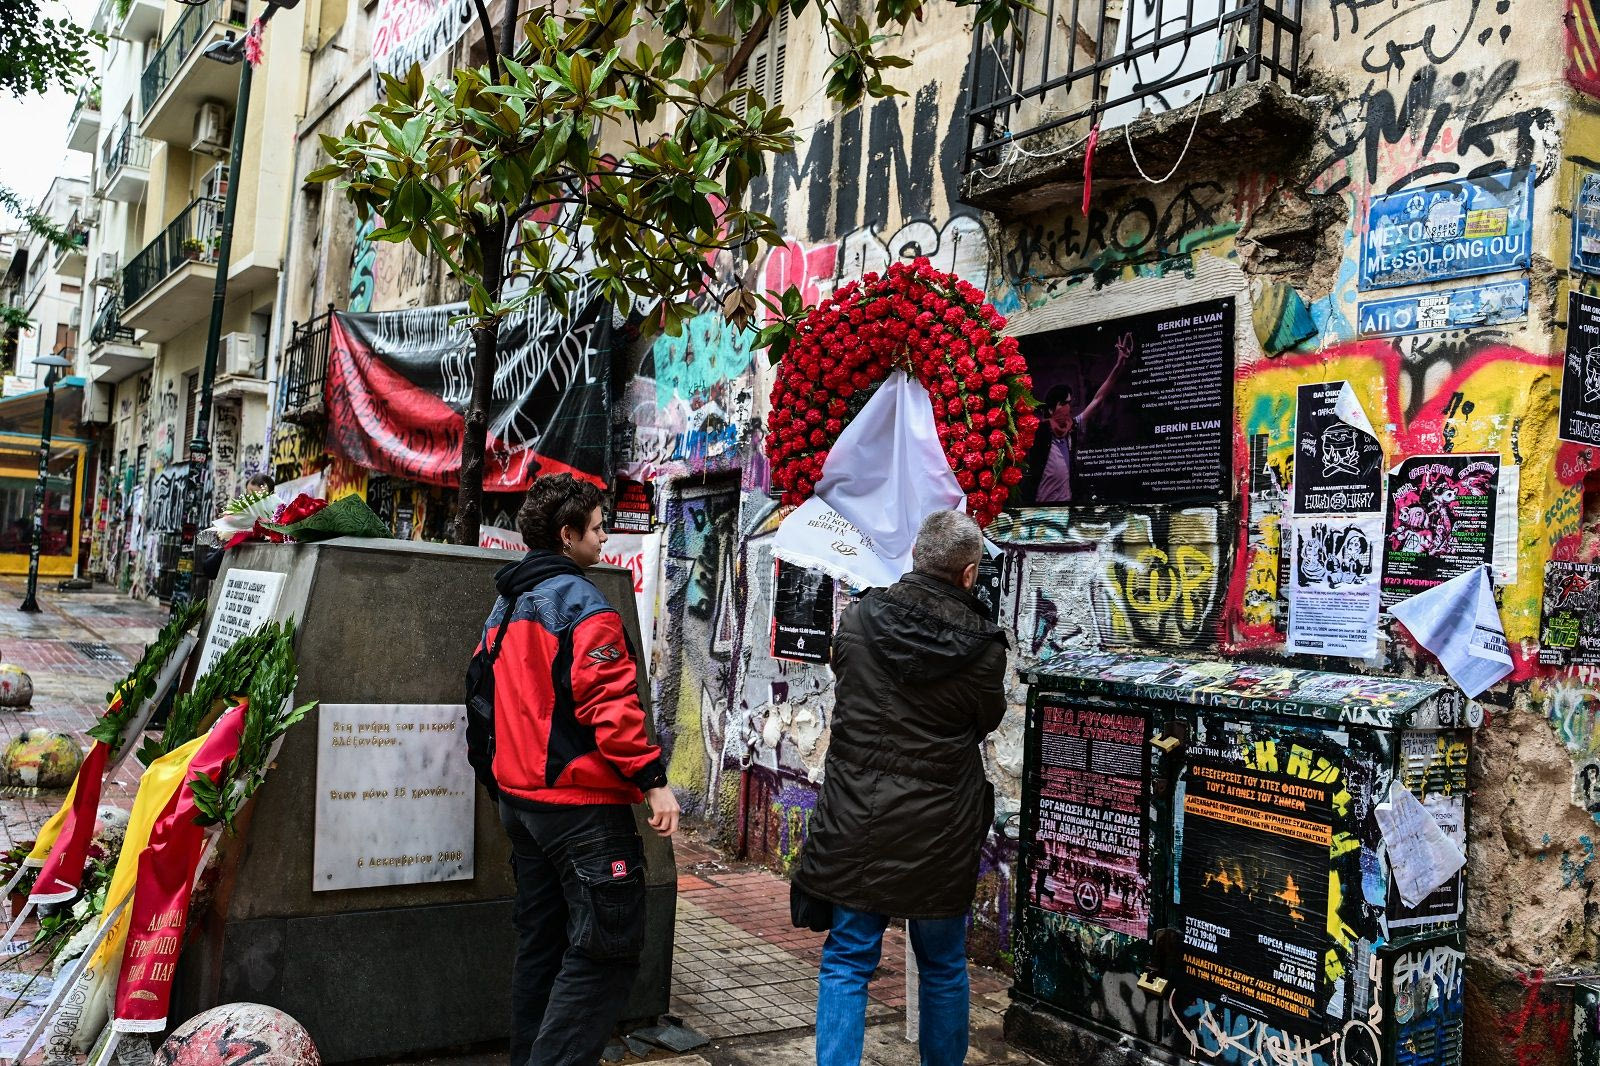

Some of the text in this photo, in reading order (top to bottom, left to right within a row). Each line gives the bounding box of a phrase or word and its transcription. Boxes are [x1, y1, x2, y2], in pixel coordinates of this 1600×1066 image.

[1368, 235, 1520, 274] MESSOLONGIOU
[1419, 297, 1448, 307] GRUPPO
[1193, 311, 1223, 325] ELVAN
[1190, 419, 1221, 431] ELVAN
[393, 787, 406, 797] 15
[1201, 766, 1242, 785] ΕΞΕΓΕΡΣΕΙΣ
[1243, 774, 1259, 787] ΤΟΥ
[1260, 778, 1280, 793] ΧΤΕΣ
[1281, 783, 1325, 802] ΦΩΤΙΖΟΥΝ
[1206, 781, 1226, 794] ΤΟΥΣ
[1227, 785, 1256, 801] ΑΓΩΝΕΣ
[1257, 791, 1272, 804] ΤΟΥ
[1040, 798, 1141, 828] ΟΡΓΑΝΩΣΗ ΚΑΙ ΑΓΩΝΑΣ
[1040, 818, 1140, 849] ΤΗΝ ΑΝΑΡΧΙΑ ΚΑΙ ΤΟΝ
[1185, 926, 1217, 943] 5/12 19:00
[1258, 934, 1284, 950] ΠΟΡΕΙΑ
[1224, 967, 1232, 979] ΣΕ
[1279, 962, 1317, 982] 6/12 18:00
[1273, 970, 1316, 993] ΠΡΟΠΥΛΑΙΑ
